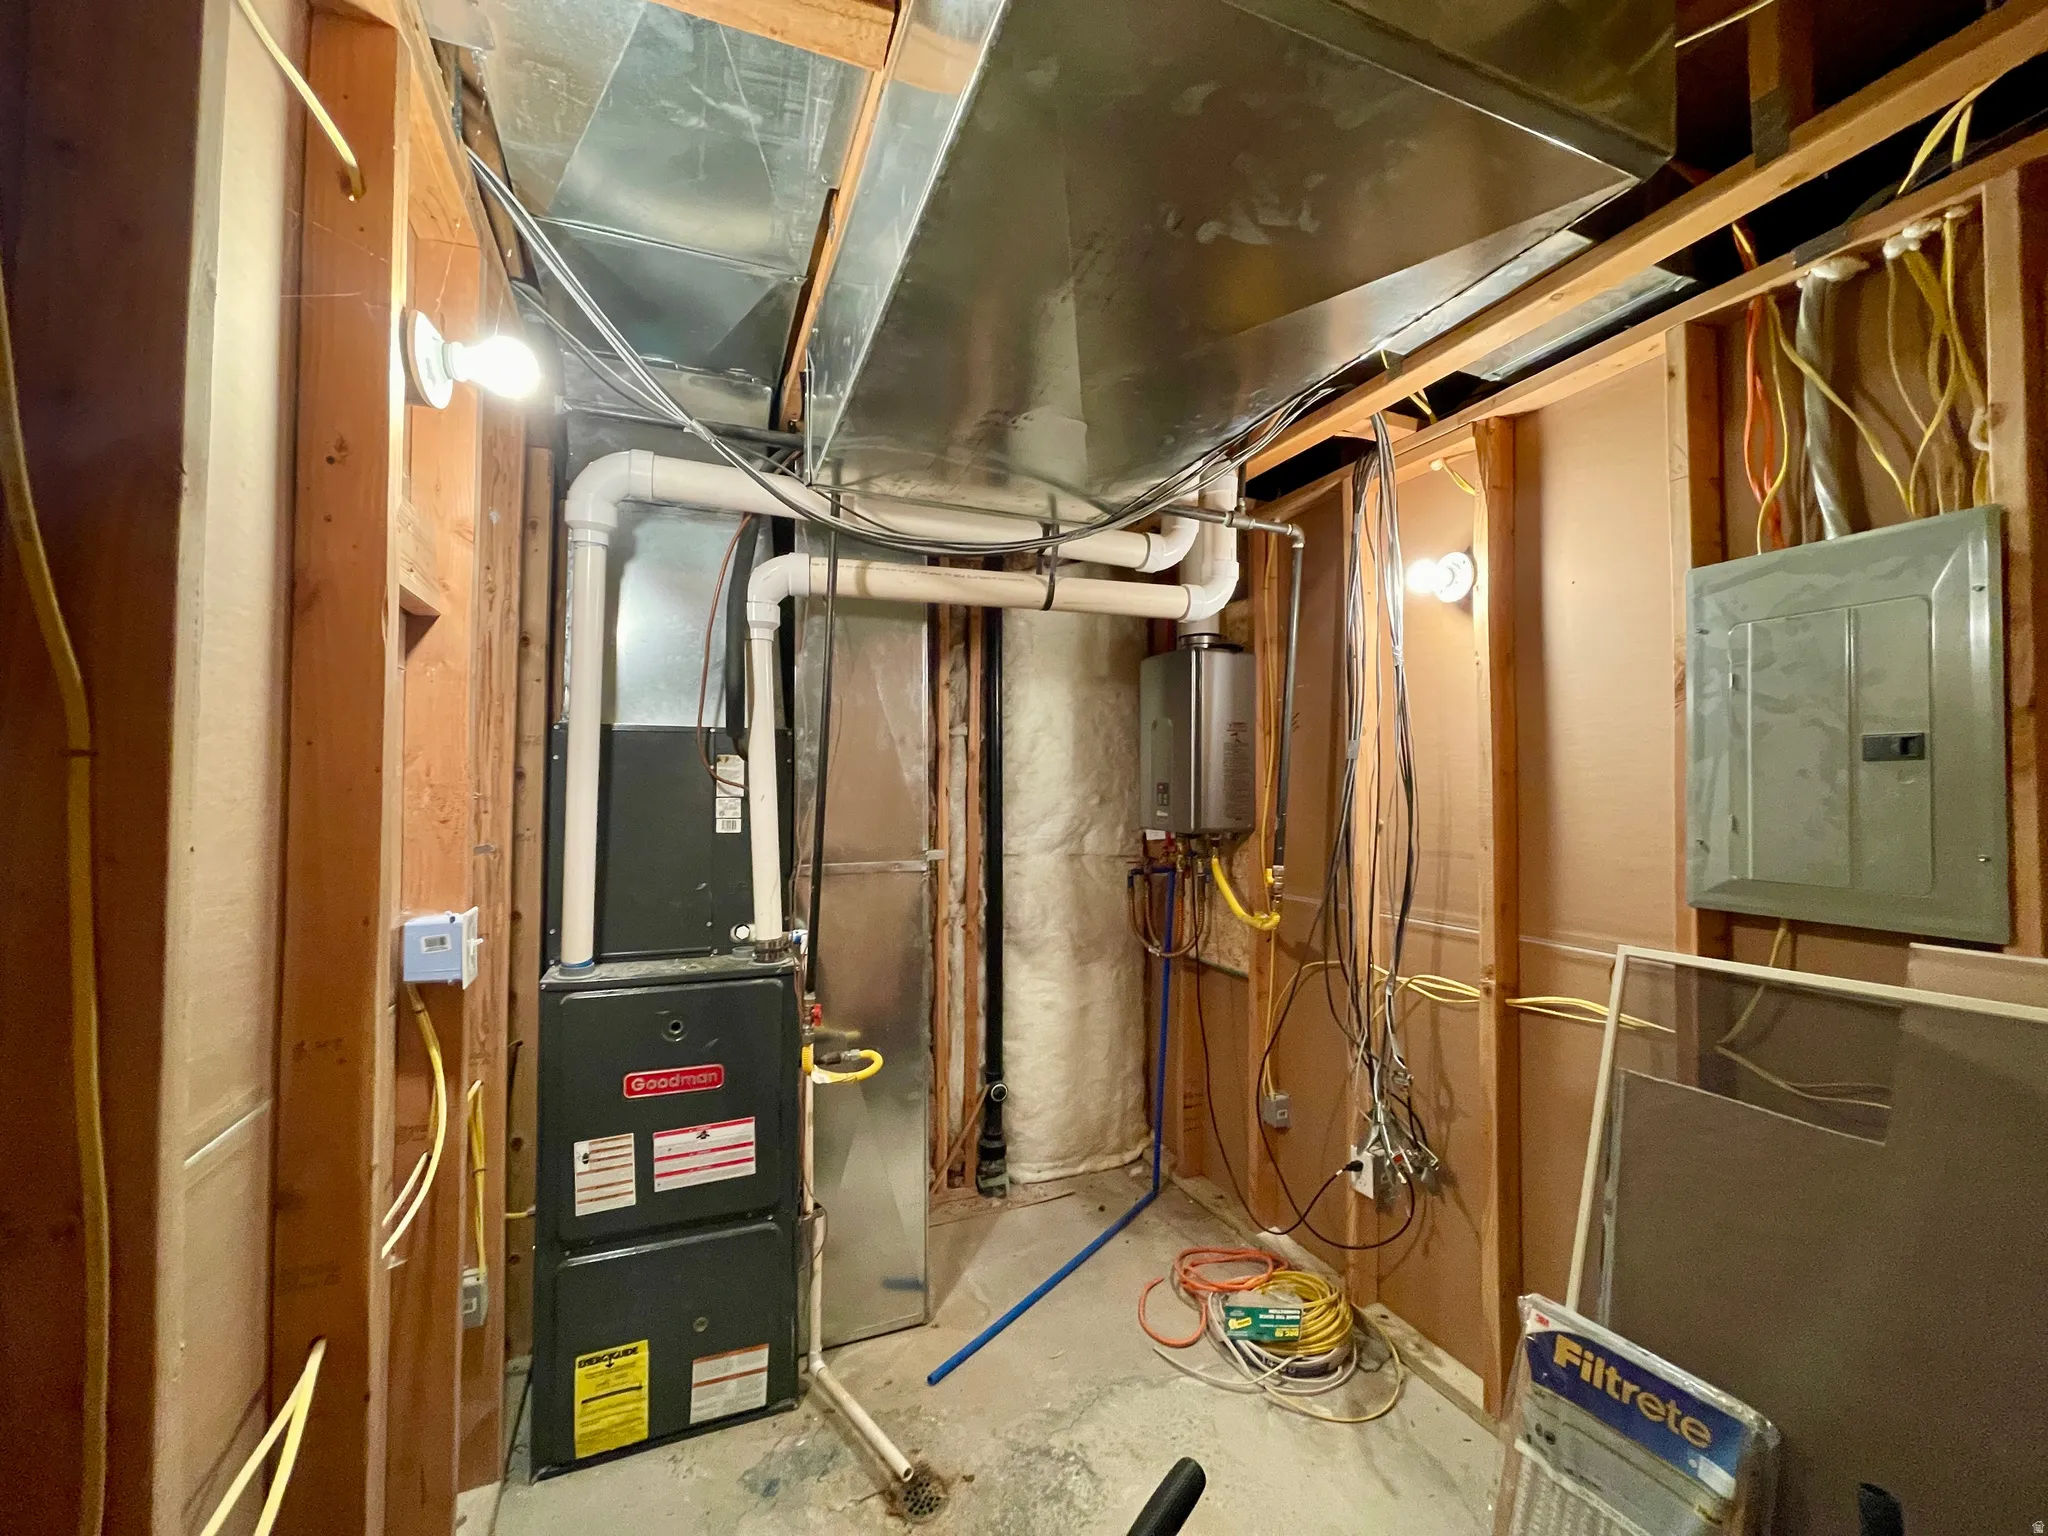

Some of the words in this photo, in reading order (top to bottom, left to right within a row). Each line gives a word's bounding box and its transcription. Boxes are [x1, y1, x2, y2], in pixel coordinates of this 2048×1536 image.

[631, 1071, 718, 1092] Goodman
[1535, 1313, 1550, 1328] 3M
[1553, 1334, 1712, 1449] Filtrete
